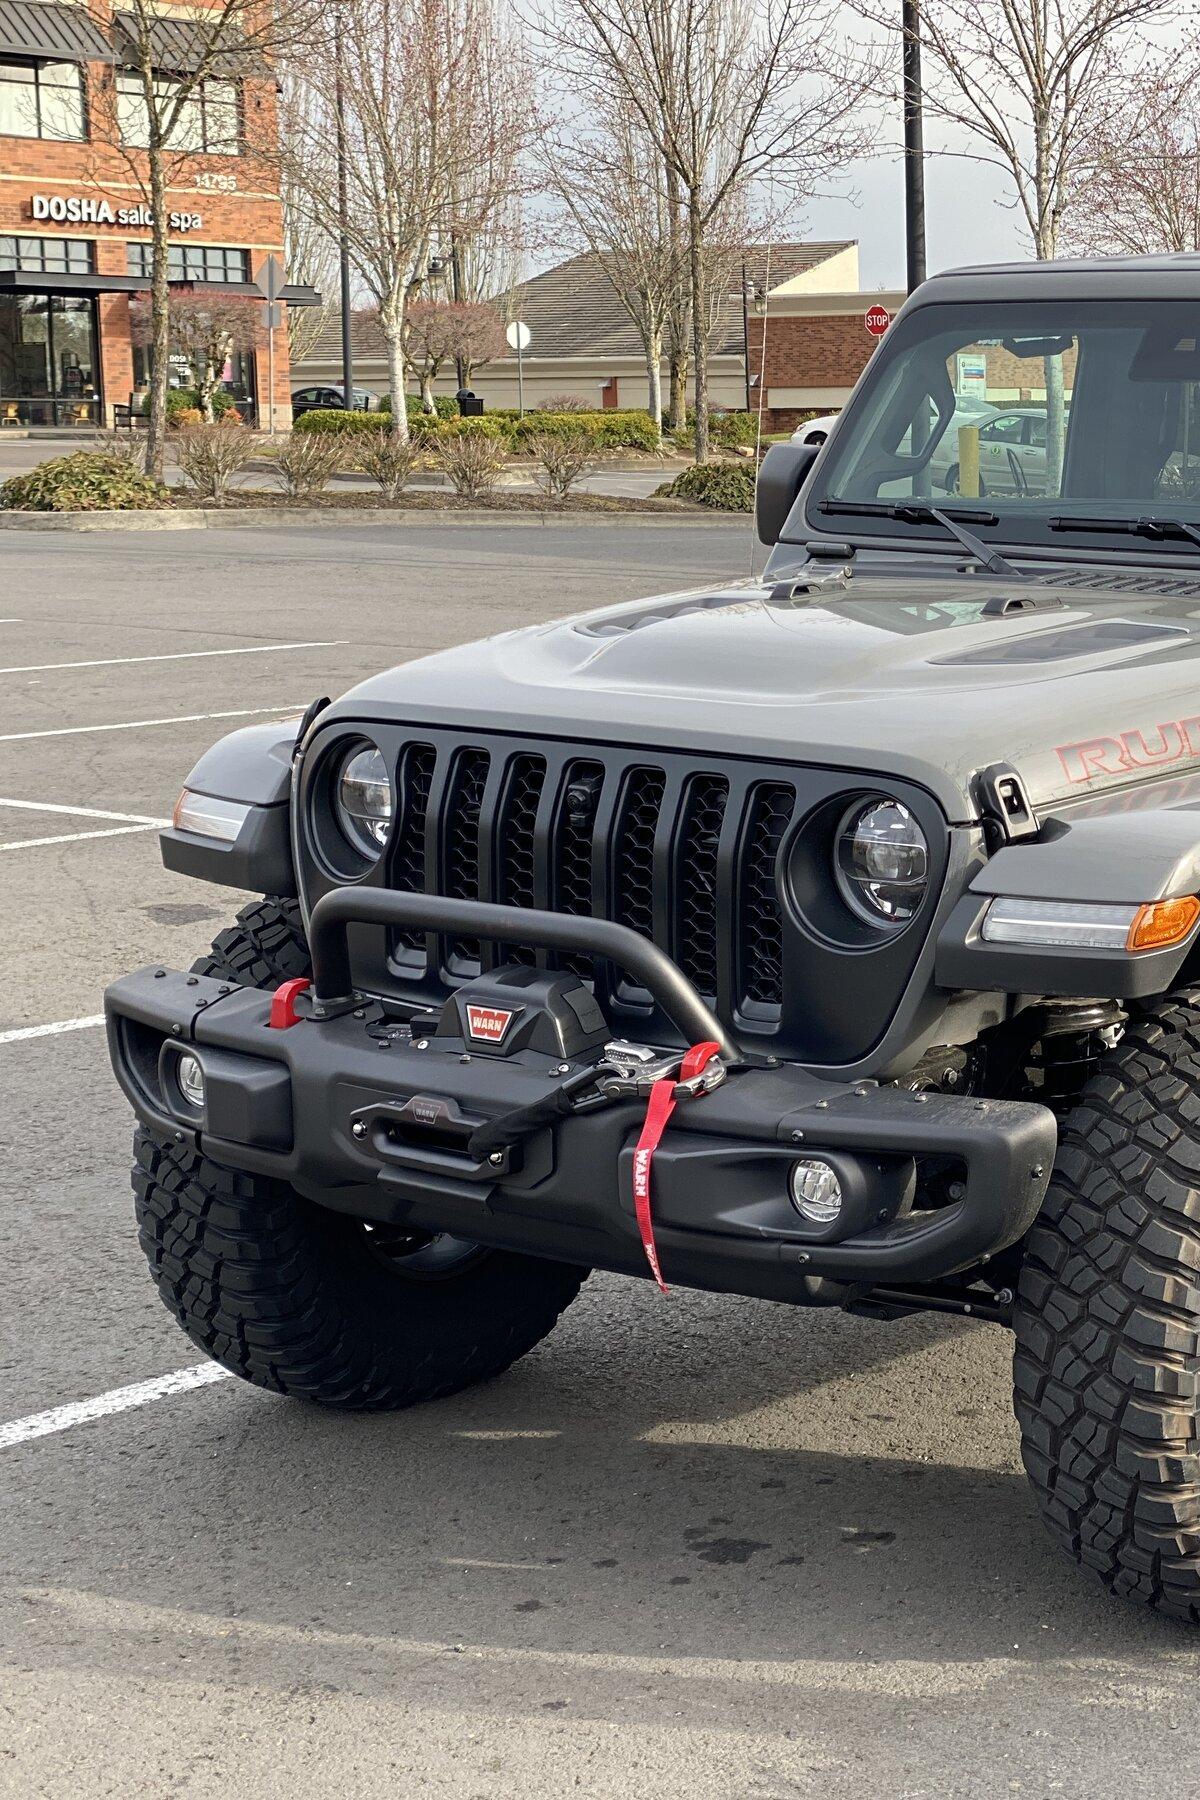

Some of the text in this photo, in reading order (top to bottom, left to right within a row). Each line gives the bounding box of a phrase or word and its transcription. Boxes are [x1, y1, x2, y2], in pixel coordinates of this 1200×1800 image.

[32, 195, 202, 232] DOSHA salo spa
[867, 315, 887, 326] STOP
[473, 1016, 502, 1032] WARN
[635, 1149, 650, 1197] WARN
